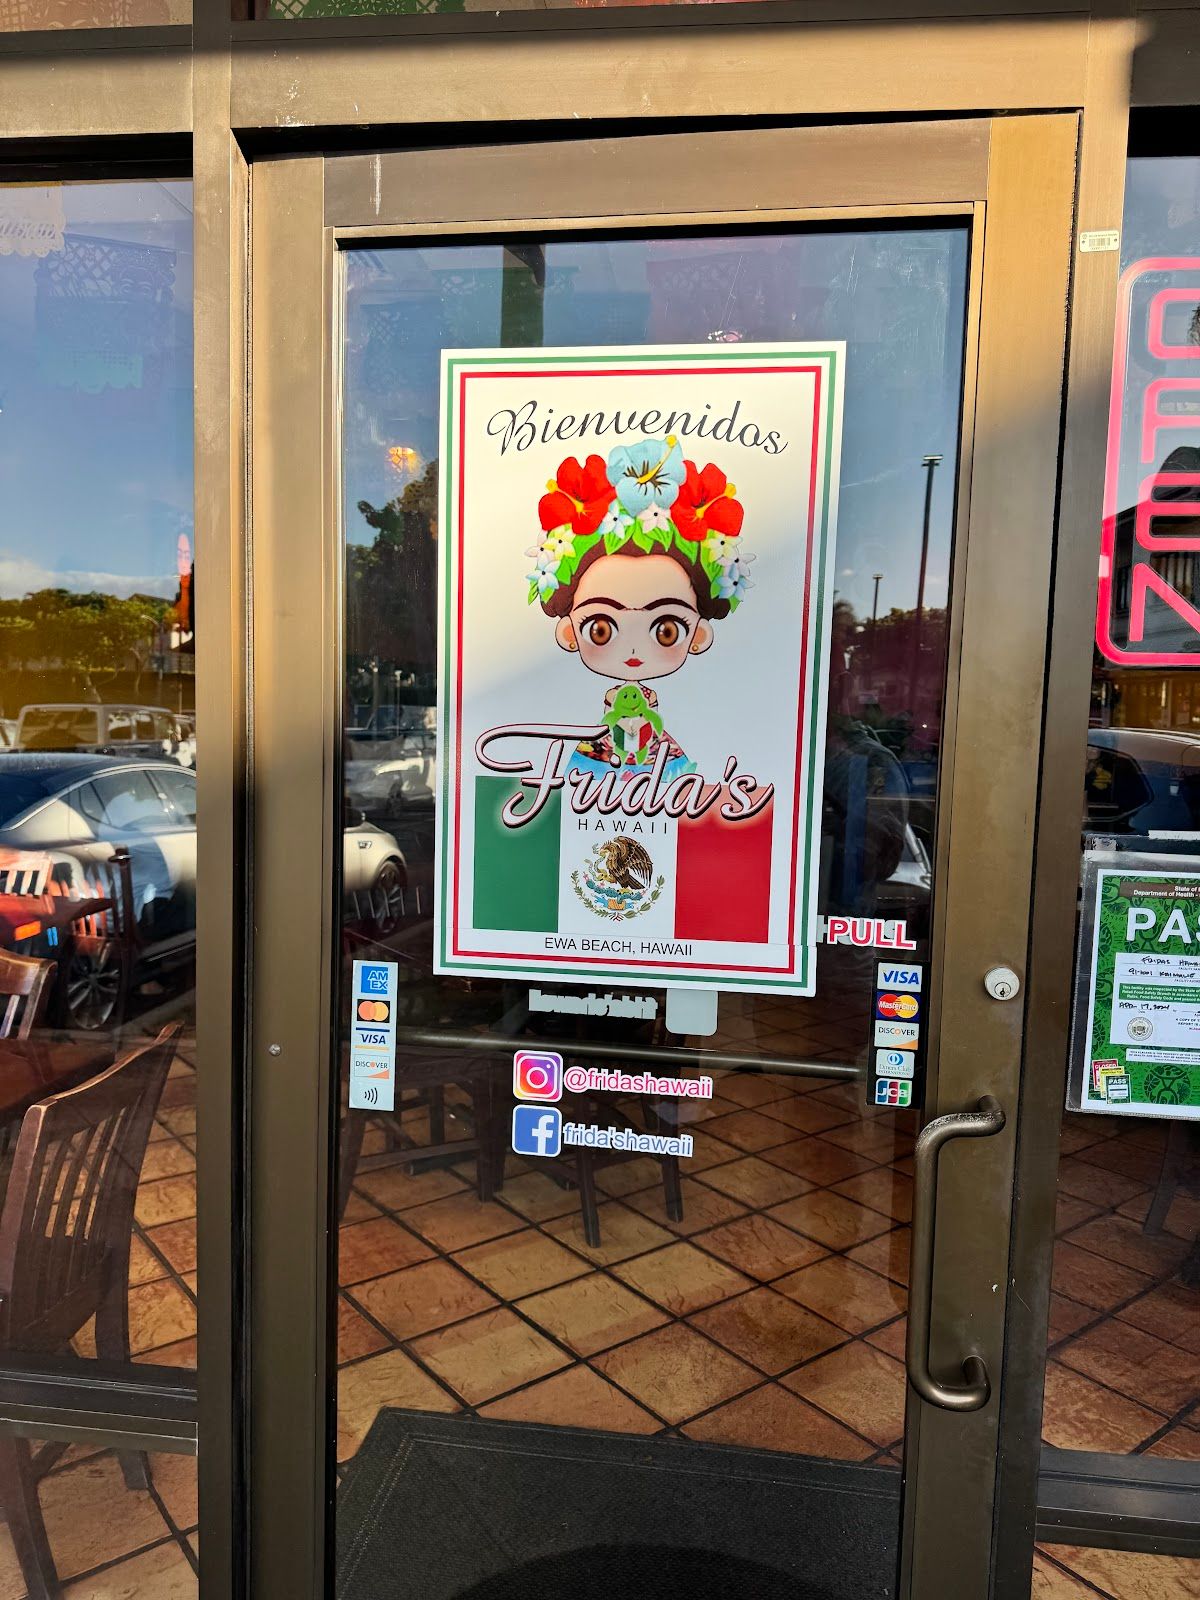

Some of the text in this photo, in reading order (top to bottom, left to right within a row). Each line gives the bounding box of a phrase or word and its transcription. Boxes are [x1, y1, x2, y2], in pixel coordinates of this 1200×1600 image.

[487, 400, 788, 456] Bienvenidos
[475, 723, 775, 828] Frida's
[577, 818, 668, 835] HAWAII
[1133, 889, 1168, 897] Department
[828, 917, 916, 949] PULL
[1126, 907, 1200, 944] PA
[544, 936, 693, 956] EWA BEACH, HAWAII
[883, 970, 920, 985] VISA
[361, 1033, 387, 1045] VISA
[878, 1026, 915, 1037] DISCOVER
[355, 1060, 388, 1069] DISCOVER
[565, 1067, 711, 1097] @fridashawaii
[564, 1124, 692, 1155] frida'shawaii
